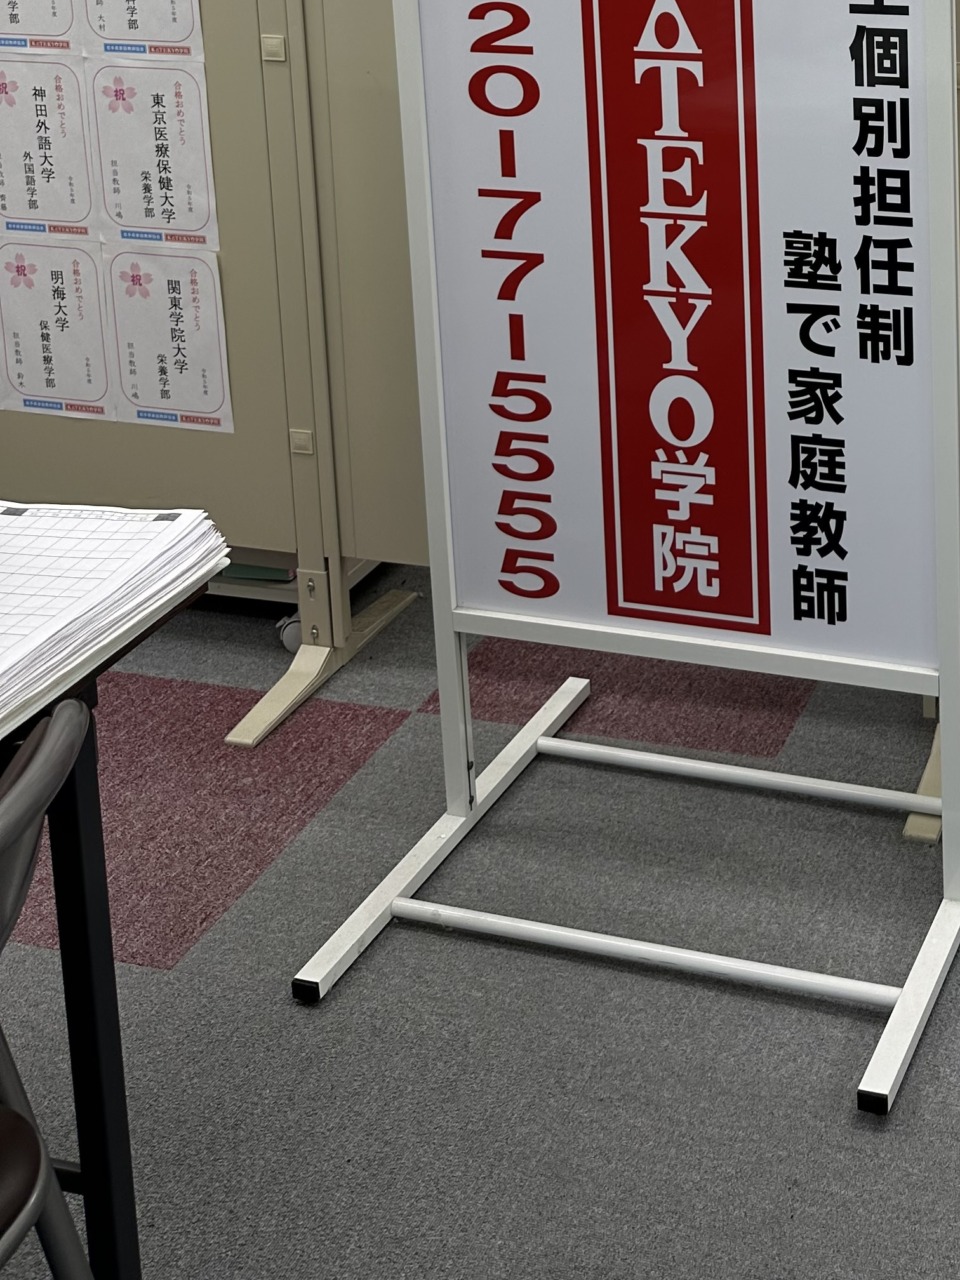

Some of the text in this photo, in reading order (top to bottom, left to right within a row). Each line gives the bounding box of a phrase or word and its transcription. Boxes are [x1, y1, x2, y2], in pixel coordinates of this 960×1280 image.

[54, 75, 67, 138] 合格おめでとう
[114, 88, 126, 101] 祝
[174, 81, 186, 145] 合格おめでとう
[32, 87, 56, 183] 神田外語大学
[151, 93, 176, 223] 東京医療保健大学
[23, 151, 39, 210] 外国語学部
[141, 171, 156, 218] 栄養学部
[15, 264, 27, 277] 祝
[51, 270, 69, 332] 明海大学
[72, 259, 84, 320] 合格おめでとう
[131, 274, 143, 286] 祝
[189, 269, 201, 332] 合格おめでとう
[39, 320, 56, 388] 保健医療学部
[167, 280, 188, 374] 関東学院大学
[157, 354, 171, 400] 栄養学部
[783, 230, 848, 626] 塾で家庭教師
